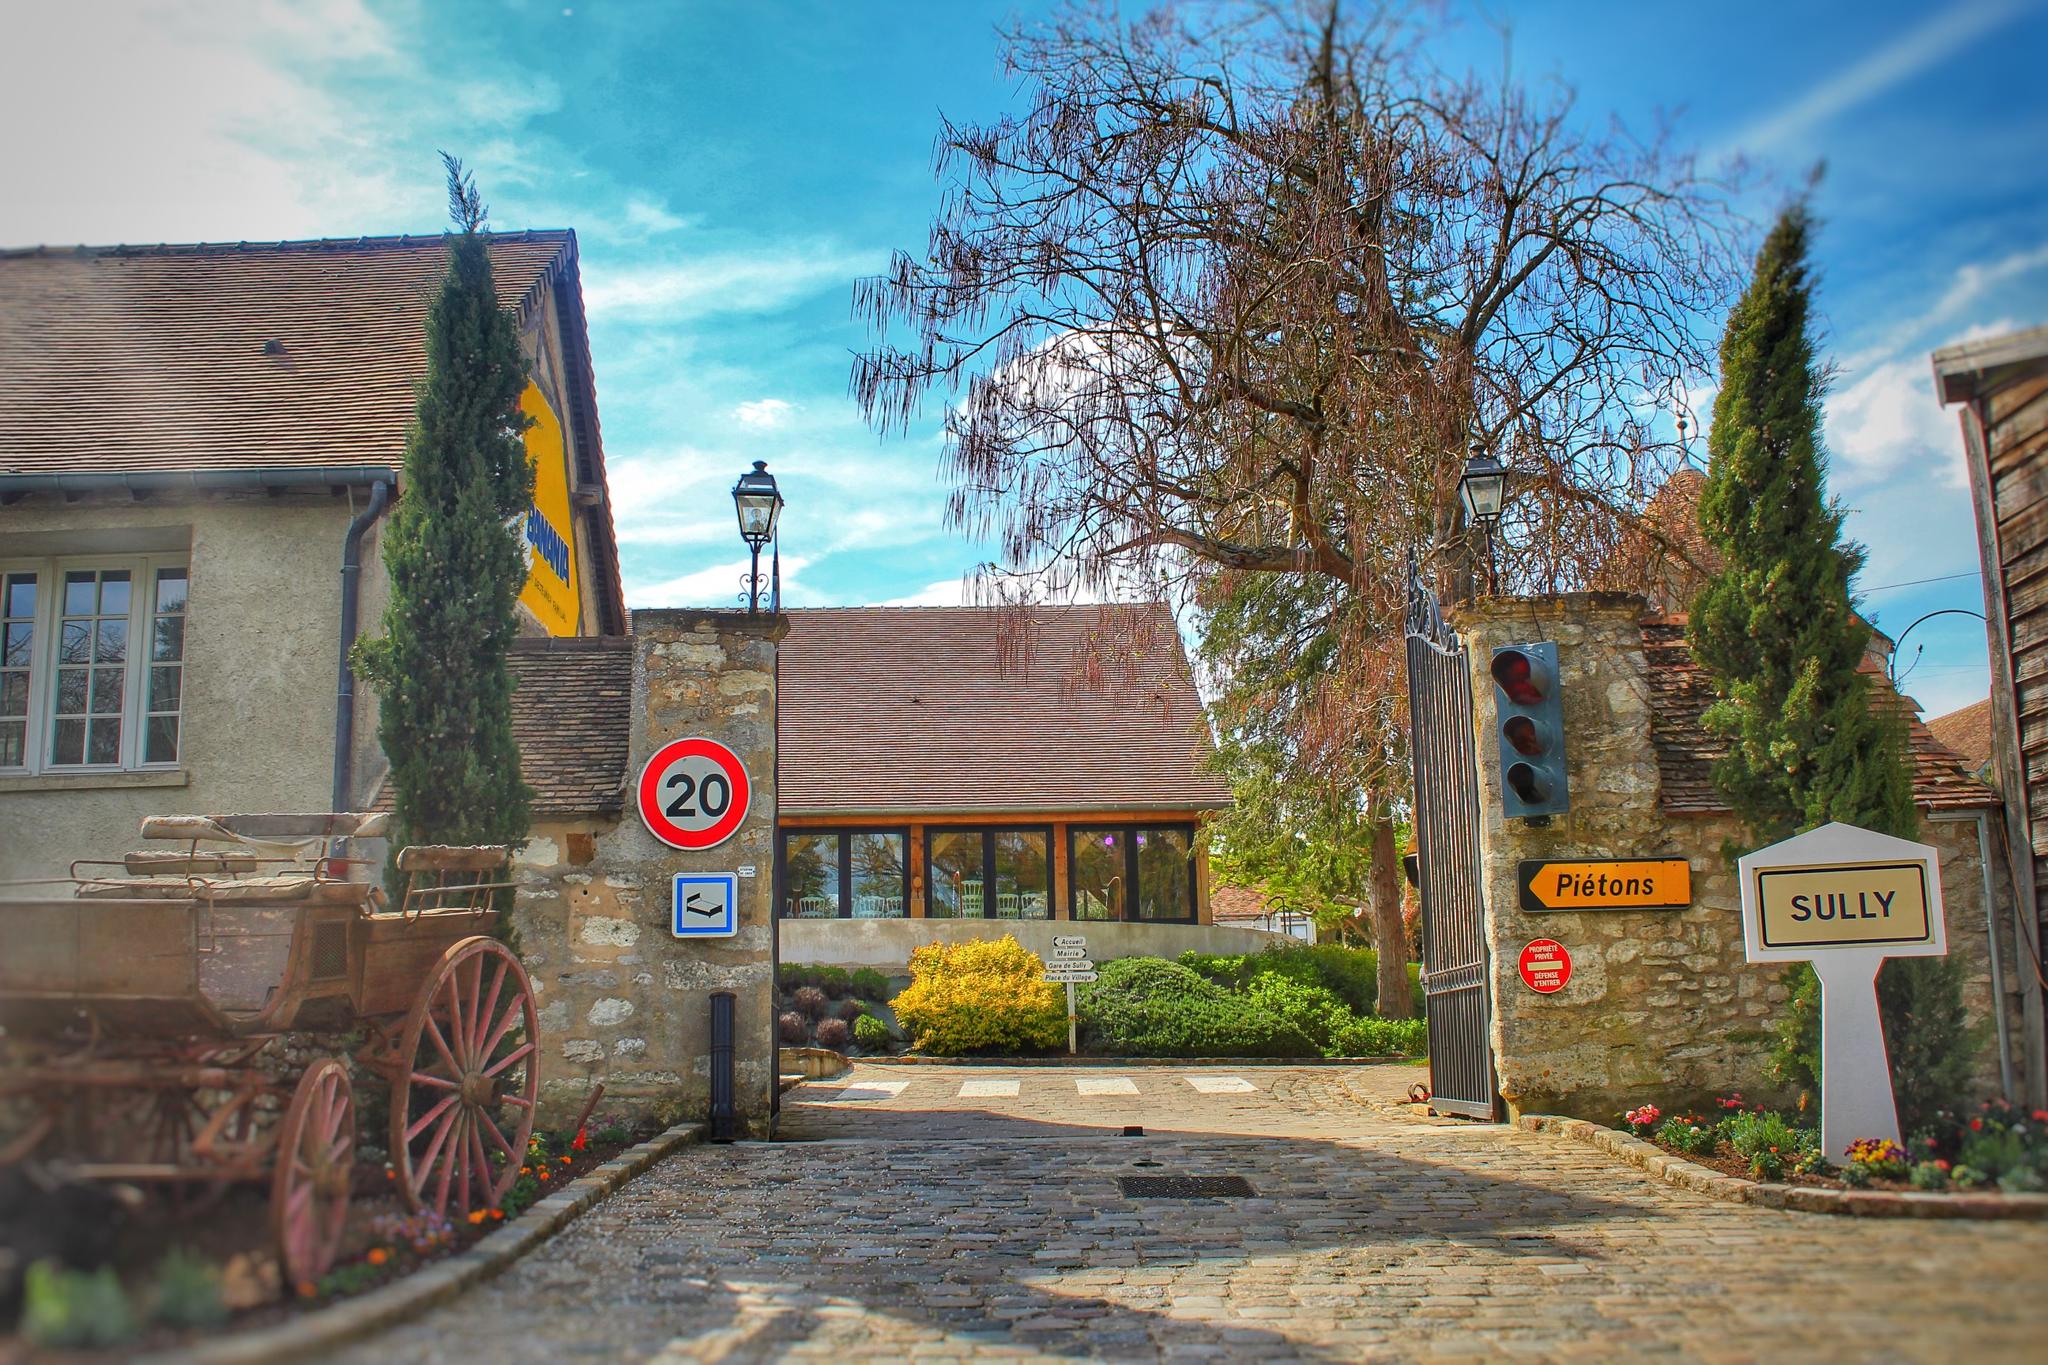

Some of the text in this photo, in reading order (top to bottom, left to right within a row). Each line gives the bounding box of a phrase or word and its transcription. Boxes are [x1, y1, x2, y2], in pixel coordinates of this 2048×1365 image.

[527, 500, 570, 589] BANANIA
[666, 773, 730, 818] 20
[1556, 873, 1654, 897] Piétons
[1791, 891, 1896, 922] SULLY
[1528, 944, 1558, 953] PROPRIÉTÉ
[1534, 952, 1553, 960] PRIVÉE
[1533, 979, 1560, 987] D'ENTRER
[1534, 971, 1559, 979] DÉFENSE
